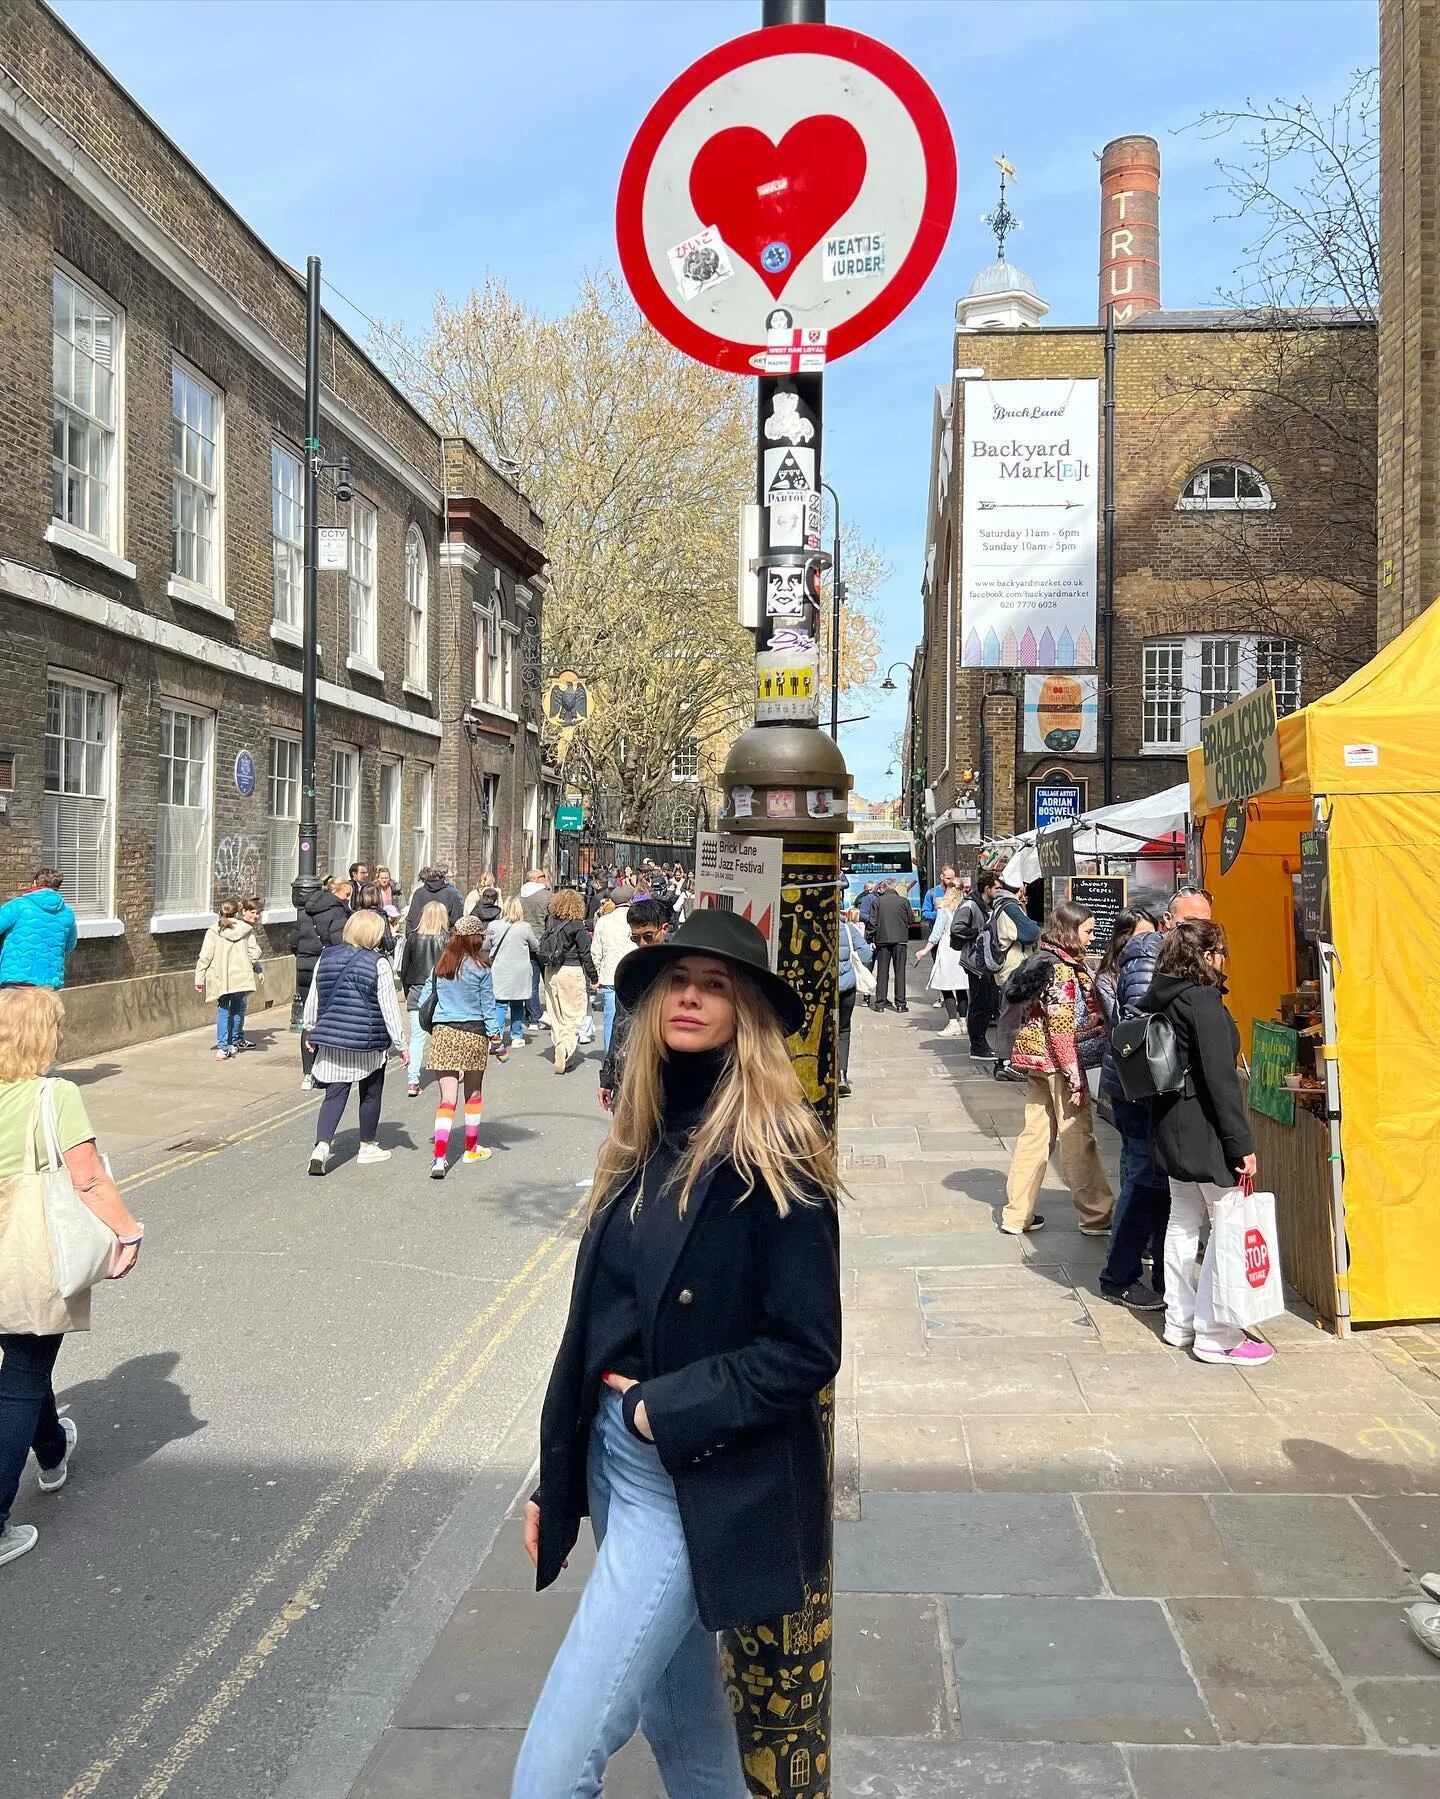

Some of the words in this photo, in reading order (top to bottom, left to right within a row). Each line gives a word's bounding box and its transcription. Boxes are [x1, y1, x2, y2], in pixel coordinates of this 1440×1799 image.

[827, 238, 863, 256] MEAT
[868, 236, 880, 251] IS
[992, 404, 1029, 420] Brick
[1030, 406, 1065, 419] Lane
[971, 439, 1071, 461] Backyard
[320, 530, 345, 538] CCTV
[979, 528, 1022, 540] Saturday
[1025, 528, 1050, 538] 11am
[1058, 528, 1080, 539] 6pm
[982, 542, 1019, 552] Sunday
[1021, 542, 1046, 551] 10am
[1055, 542, 1077, 552] 5pm
[975, 580, 1084, 589] www.backyardmarket.co.uk
[969, 590, 1089, 599] facebook.com/backyardmarket
[1000, 601, 1015, 609] 020
[1017, 601, 1036, 609] 7770
[1038, 600, 1058, 608] 6028
[1202, 690, 1275, 766] BRAZILICIOUS
[1216, 742, 1266, 800] CHURROS
[1041, 797, 1073, 807] ADRIAN
[1038, 806, 1076, 816] BOSWELL
[719, 841, 738, 854] Brick
[739, 843, 757, 856] Lane
[718, 857, 734, 870] Jazz
[735, 859, 764, 874] Festival
[1244, 1245, 1267, 1270] STOP
